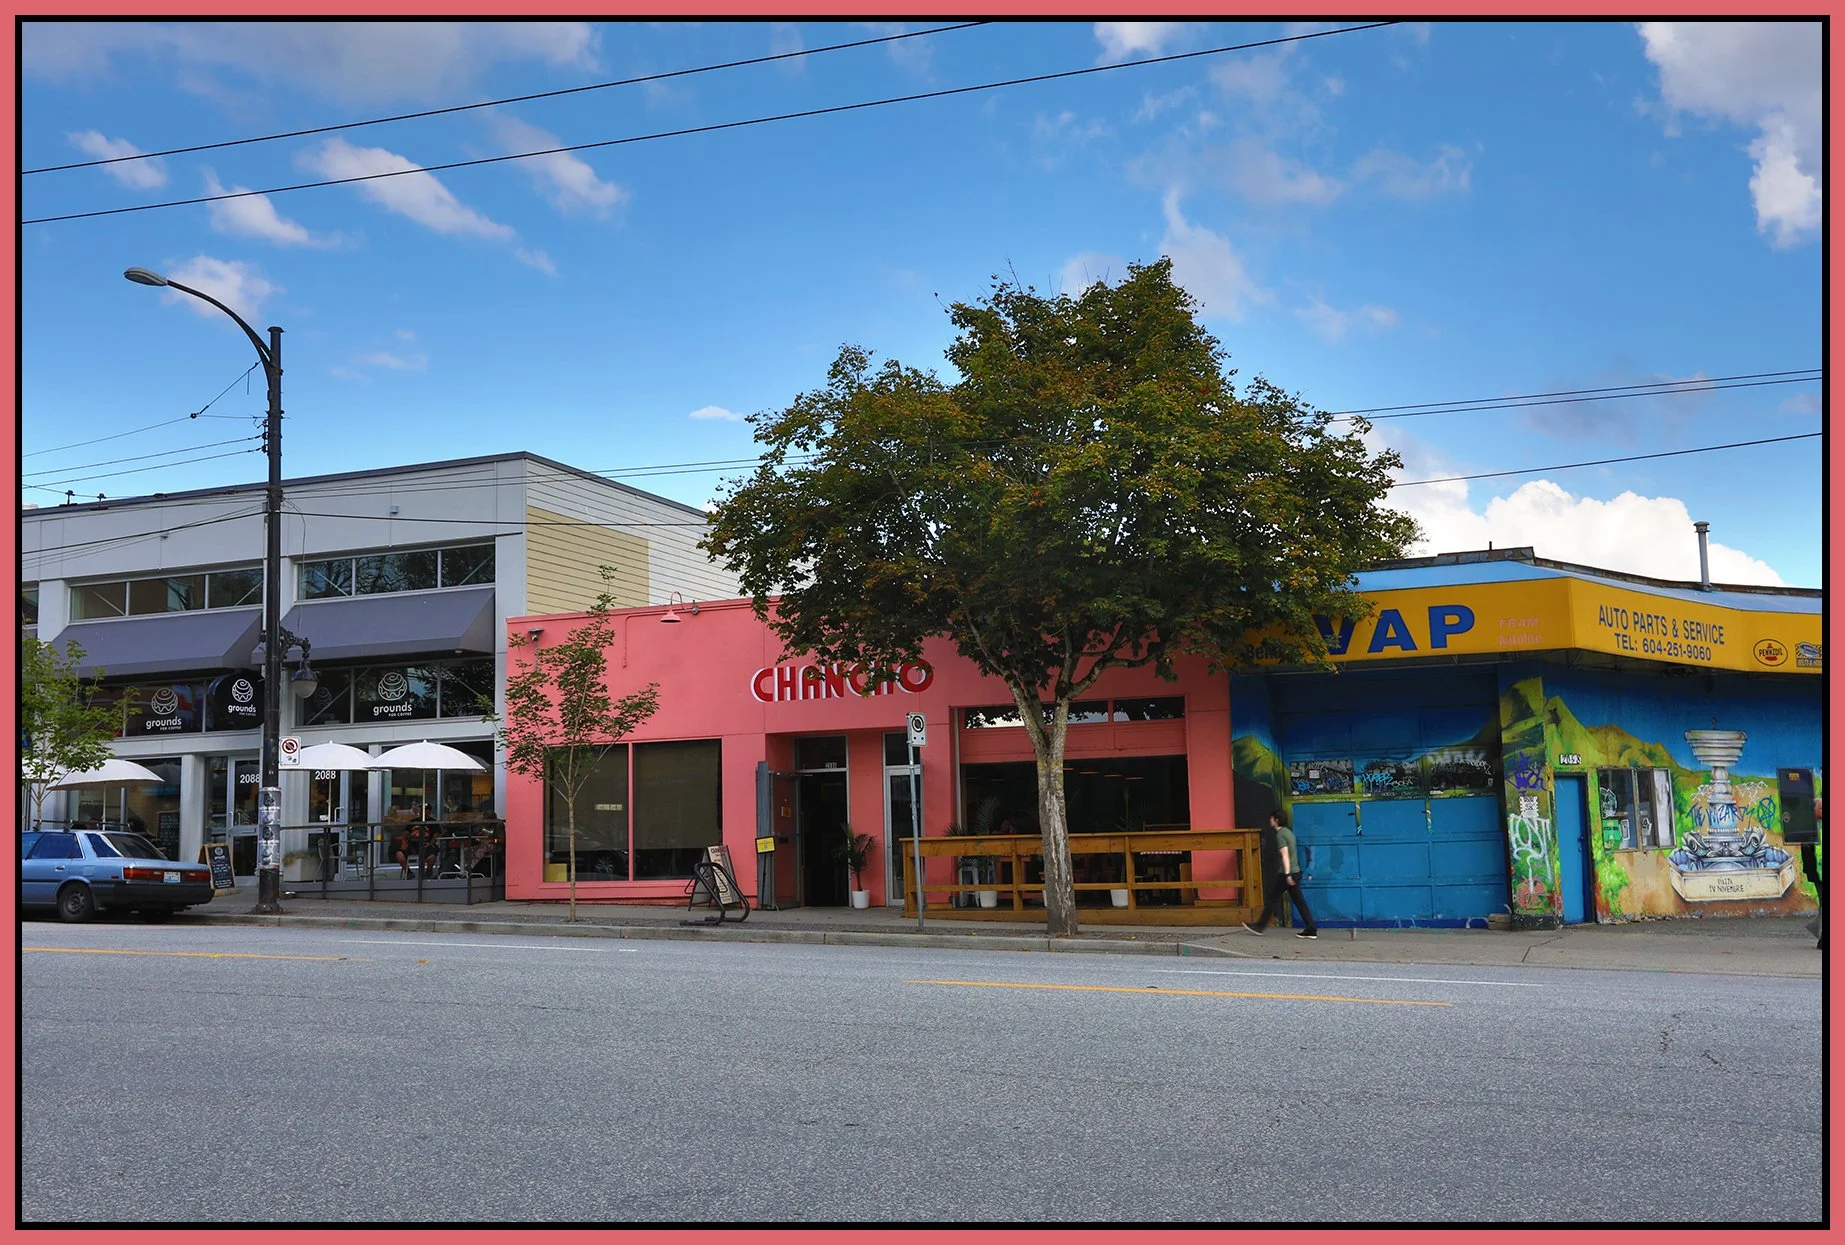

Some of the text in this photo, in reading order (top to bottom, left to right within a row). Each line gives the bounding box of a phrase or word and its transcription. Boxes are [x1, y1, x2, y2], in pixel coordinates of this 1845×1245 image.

[1499, 617, 1539, 628] FRAM
[1599, 605, 1725, 645] AUTO PARTS & SERVICE
[1614, 633, 1712, 661] TEL: 604-251-9060
[227, 704, 257, 714] grounds
[373, 701, 412, 716] grounds
[146, 716, 182, 730] grounds
[240, 773, 260, 784] 2088
[315, 770, 336, 780] 2088
